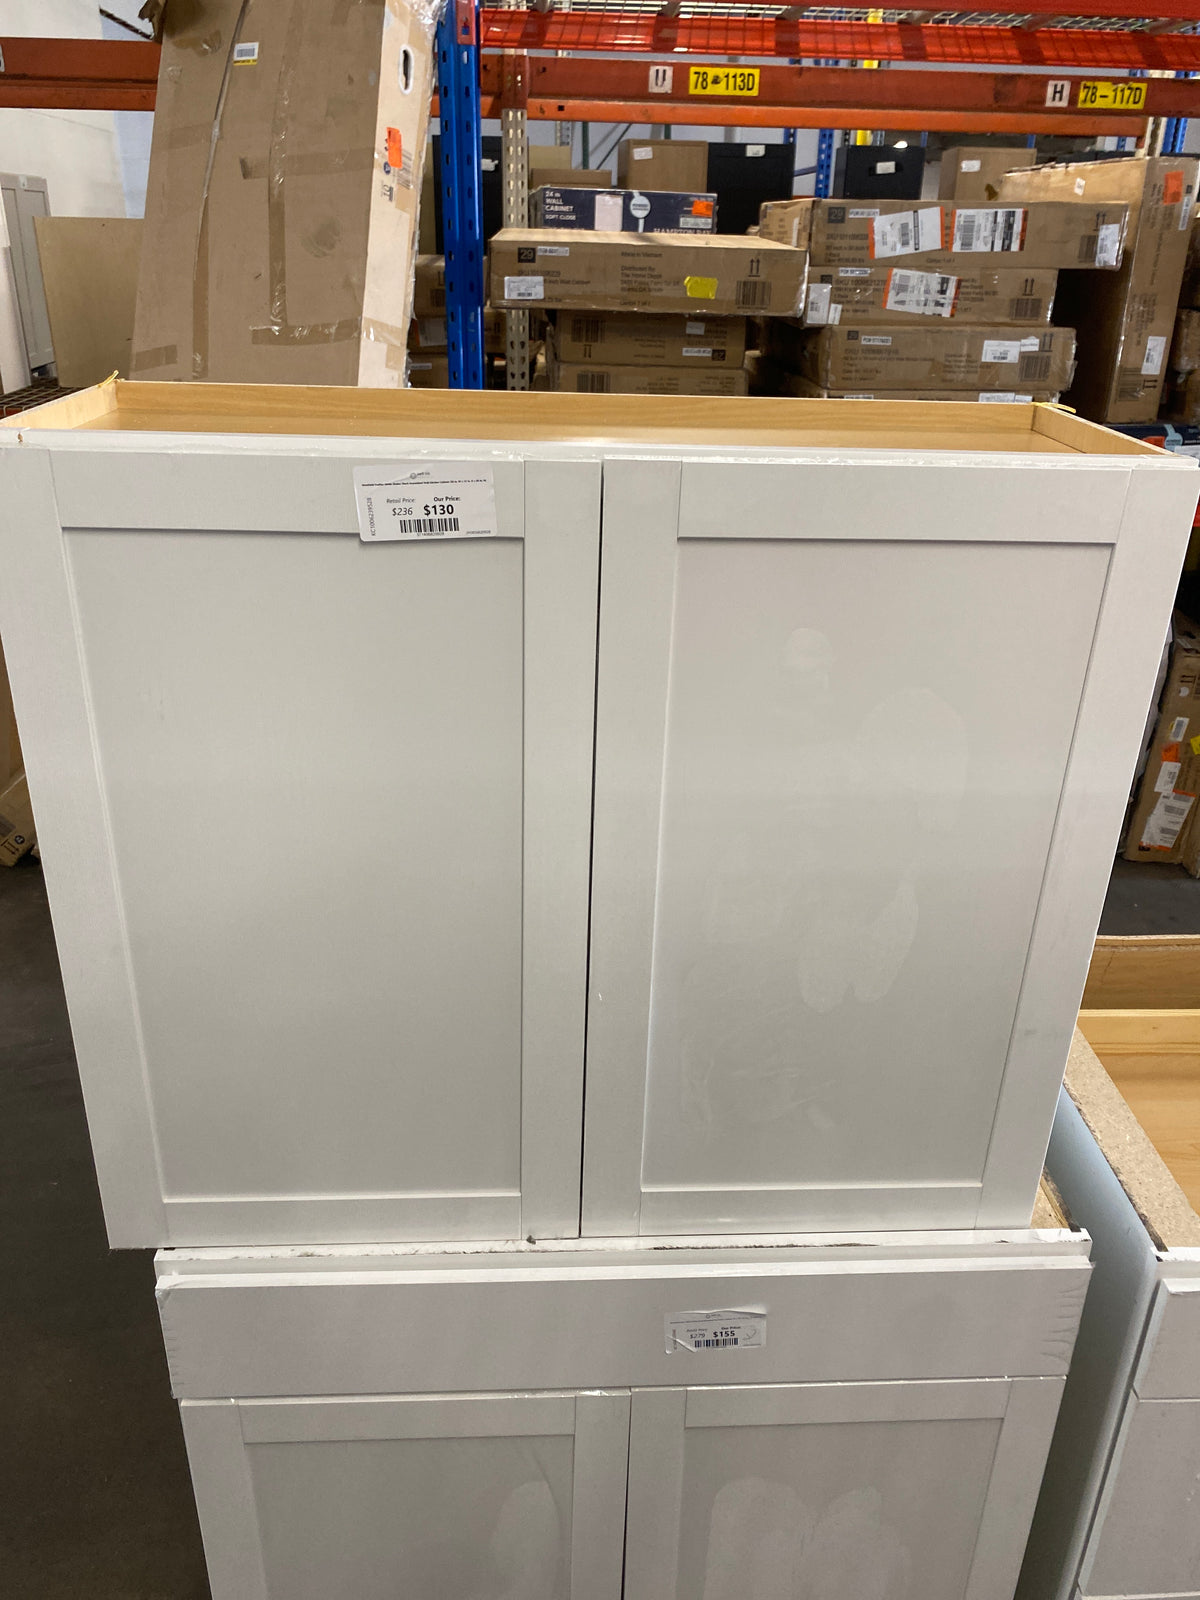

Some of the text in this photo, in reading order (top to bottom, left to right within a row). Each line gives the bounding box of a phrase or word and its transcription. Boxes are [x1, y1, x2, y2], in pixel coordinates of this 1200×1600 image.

[1051, 83, 1065, 102] H
[520, 249, 534, 260] 29
[392, 507, 413, 517] $236
[423, 504, 454, 516] $130
[712, 1330, 736, 1338] $155
